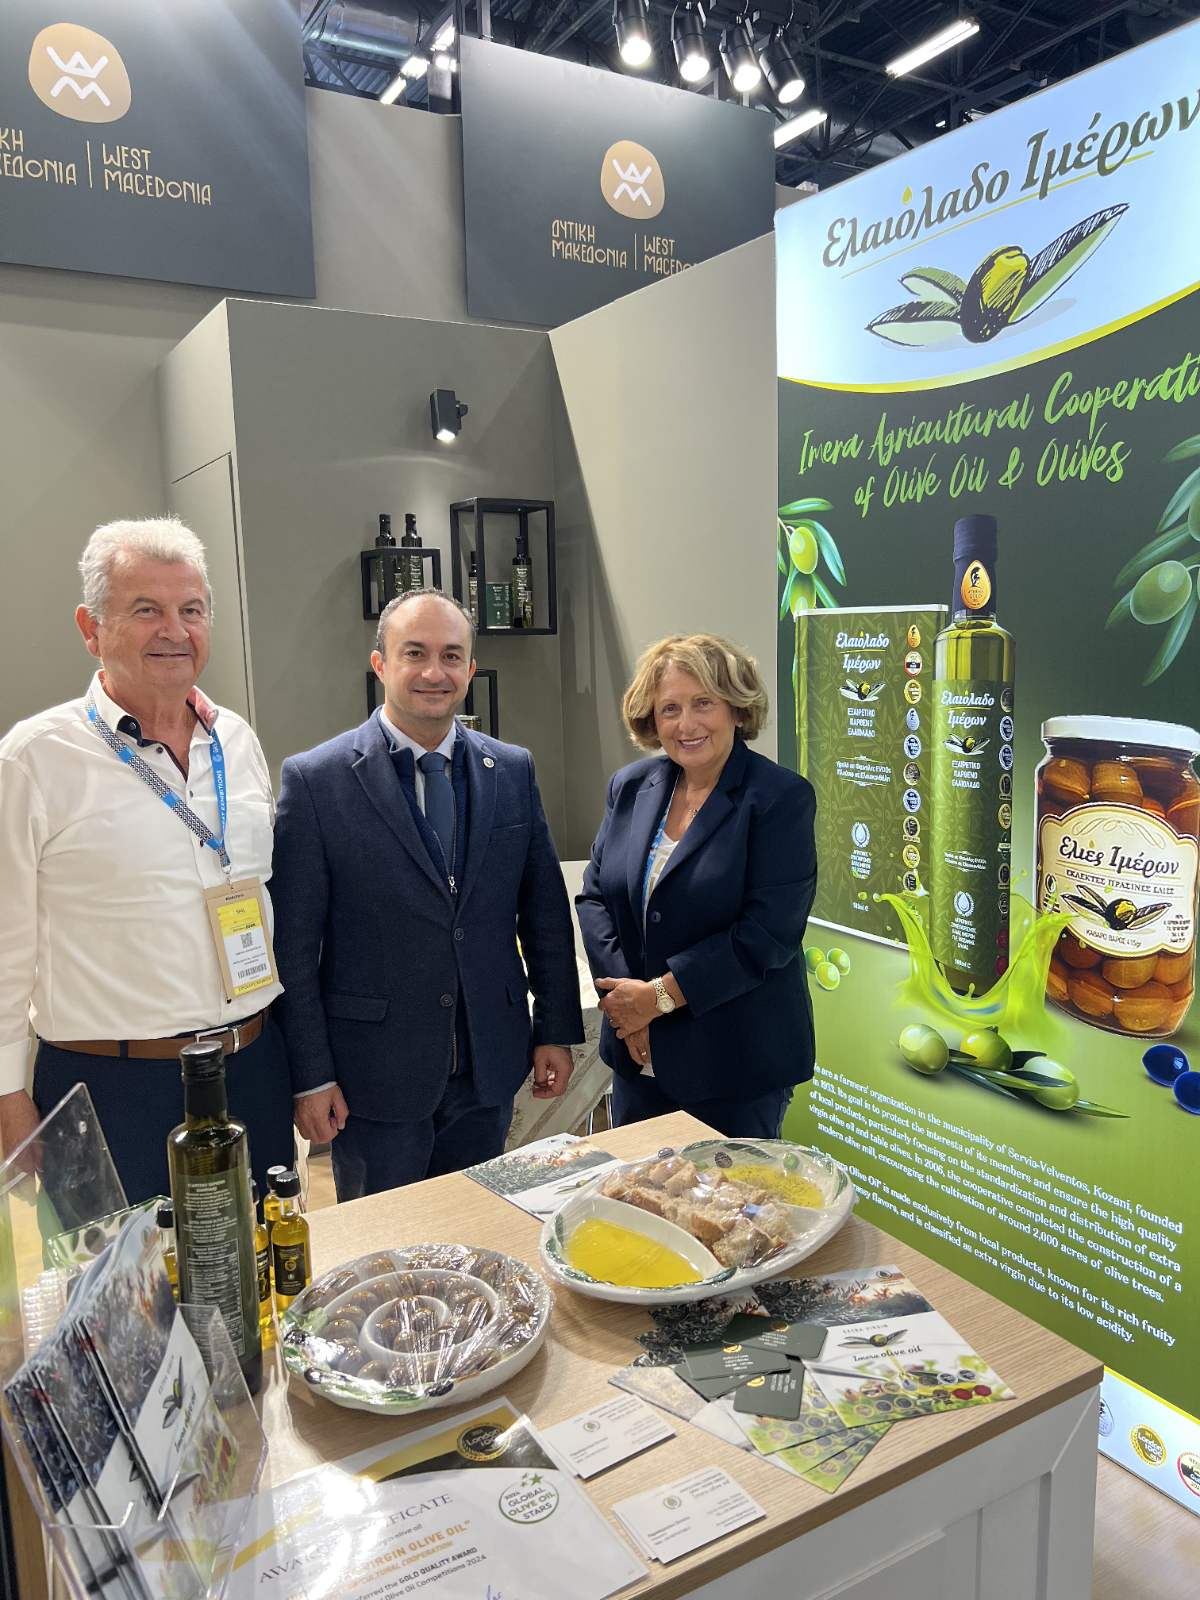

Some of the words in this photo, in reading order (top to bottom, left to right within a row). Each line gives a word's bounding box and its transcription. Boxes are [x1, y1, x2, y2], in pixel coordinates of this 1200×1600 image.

[102, 143, 152, 172] WEST
[1020, 88, 1200, 200] Ιμέρων
[0, 153, 77, 186] ΕΔΟΝΙΑ
[104, 168, 212, 206] MACEDONIA
[551, 219, 596, 243] ΔΥΤΙΚΗ
[644, 234, 676, 257] WEST
[551, 240, 628, 269] ΜΑΚΕΔΟΝΙΑ
[798, 429, 864, 475] Imera
[867, 392, 1035, 468] Agricultural
[854, 474, 877, 518] of
[882, 452, 942, 508] Olive
[949, 453, 991, 498] Oil
[999, 447, 1025, 489] &
[1037, 422, 1132, 487] Olives
[1108, 846, 1180, 878] Ιμέρων
[809, 1090, 818, 1099] of
[818, 1092, 834, 1107] local
[834, 1102, 867, 1125] products,
[868, 1118, 911, 1145] particularly
[912, 1137, 947, 1162] focusing
[948, 1156, 959, 1166] on
[960, 1160, 974, 1173] the
[976, 1169, 1047, 1208] standardization
[1048, 1203, 1067, 1217] and
[1069, 1211, 1132, 1249] distribution
[1134, 1243, 1148, 1255] of
[1149, 1251, 1181, 1272] extra
[847, 1094, 863, 1107] goal
[872, 1104, 880, 1114] to
[881, 1109, 910, 1128] protect
[911, 1122, 925, 1134] the
[926, 1127, 963, 1152] interests
[964, 1146, 975, 1157] of
[976, 1149, 988, 1163] its
[1033, 1178, 1051, 1192] and
[1053, 1187, 1088, 1210] ensure
[1090, 1202, 1109, 1219] the
[1111, 1210, 1135, 1232] high
[1137, 1226, 1177, 1252] quality
[869, 1090, 917, 1116] organization
[918, 1108, 926, 1119] in
[928, 1113, 942, 1126] the
[943, 1120, 994, 1151] municipality
[996, 1144, 1007, 1154] of
[1093, 1184, 1133, 1214] Kozani,
[1135, 1203, 1183, 1234] founded
[809, 1104, 829, 1119] virgin
[828, 1114, 845, 1127] olive
[845, 1122, 855, 1132] oil
[855, 1127, 869, 1139] and
[870, 1133, 889, 1148] table
[914, 1152, 923, 1163] In
[947, 1169, 961, 1183] the
[962, 1178, 1014, 1208] cooperative
[1015, 1203, 1065, 1234] completed
[1067, 1227, 1085, 1244] the
[1087, 1239, 1157, 1279] construction
[1159, 1274, 1172, 1286] of
[1174, 1282, 1182, 1292] a
[878, 1153, 925, 1183] encouraging
[925, 1175, 940, 1189] the
[940, 1184, 985, 1211] cultivation
[986, 1206, 998, 1216] of
[998, 1212, 1031, 1234] around
[1032, 1227, 1059, 1248] 2,000
[1060, 1243, 1088, 1264] acres
[1090, 1259, 1103, 1270] of
[1104, 1265, 1129, 1285] olive
[1132, 1277, 1164, 1303] trees.
[882, 1183, 890, 1194] is
[890, 1189, 911, 1205] made
[912, 1200, 955, 1228] exclusively
[955, 1221, 978, 1239] from
[979, 1232, 1000, 1251] local
[1001, 1246, 1045, 1278] products,
[1047, 1267, 1080, 1295] known
[1081, 1287, 1099, 1303] for
[1101, 1297, 1115, 1314] its
[1117, 1308, 1140, 1327] rich
[1142, 1319, 1176, 1347] fruity
[900, 1209, 914, 1222] and
[915, 1215, 923, 1226] is
[924, 1221, 961, 1247] classified
[974, 1248, 998, 1267] extra
[1000, 1261, 1026, 1283] virgin
[1028, 1275, 1046, 1293] due
[1048, 1287, 1059, 1300] to
[1061, 1293, 1075, 1309] its
[1077, 1301, 1095, 1320] low
[1096, 1316, 1135, 1343] acidity.
[880, 1347, 905, 1358] olive
[907, 1344, 923, 1355] oil
[508, 1487, 546, 1508] GLOBAL
[508, 1501, 538, 1518] OLIVE
[538, 1492, 556, 1505] OIL
[523, 1502, 554, 1520] STARS
[408, 1531, 445, 1552] OLIVE
[385, 1580, 399, 1592] the
[399, 1570, 420, 1585] GOLD
[420, 1558, 451, 1576] QUALITY
[451, 1546, 478, 1562] AWARD
[405, 1583, 417, 1594] Oil
[416, 1563, 466, 1589] Competitions
[466, 1554, 488, 1568] 2024
